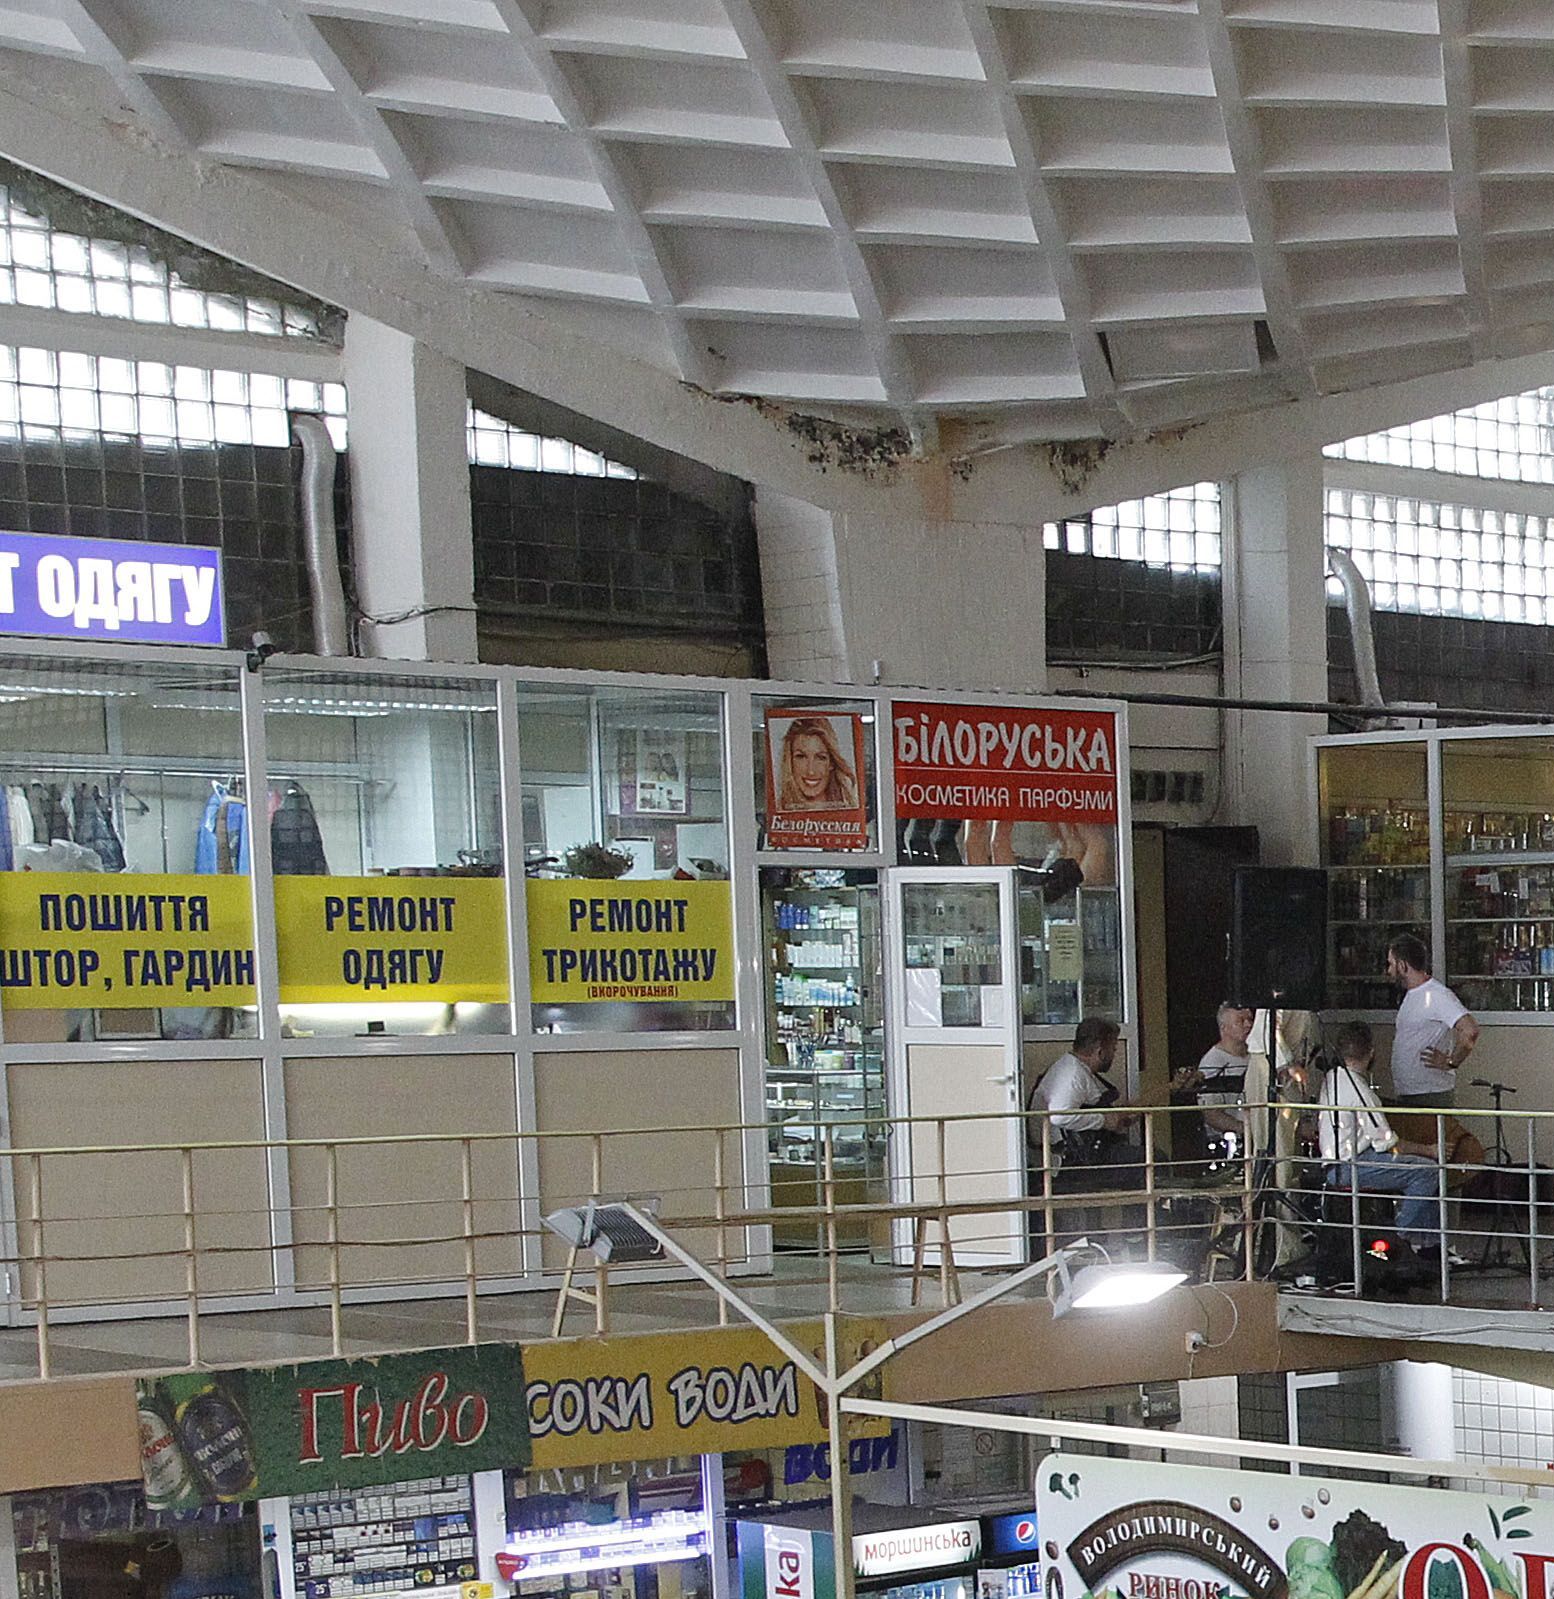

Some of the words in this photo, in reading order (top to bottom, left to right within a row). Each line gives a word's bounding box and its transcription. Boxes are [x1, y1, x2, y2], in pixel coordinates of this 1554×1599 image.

[37, 554, 215, 630] ОДЯГУ
[896, 712, 1112, 773] БІЛОРУСЬКА
[896, 783, 1009, 808] КОСМЕТИКА
[1019, 787, 1113, 811] ПАРФУМИ
[770, 814, 861, 838] Белорусская
[40, 894, 209, 933] ПОШИТТЯ
[325, 896, 455, 933] РЕМОНТ
[569, 899, 690, 934] РЕМОНТ
[0, 950, 112, 993] ШТОР,
[123, 950, 255, 995] ГАРДИН
[342, 950, 445, 990] ОДЯГУ
[542, 948, 717, 984] ТРИКОТАЖУ
[586, 984, 679, 1000] (ВКОРОЧУВАННЯ)
[298, 1371, 490, 1466] Пиво
[528, 1373, 652, 1438] СОКИ
[669, 1360, 799, 1426] ВОДИ
[863, 1528, 973, 1562] моршинська
[1079, 1514, 1272, 1590] ВОЛОДИМИРСЬКИЙ
